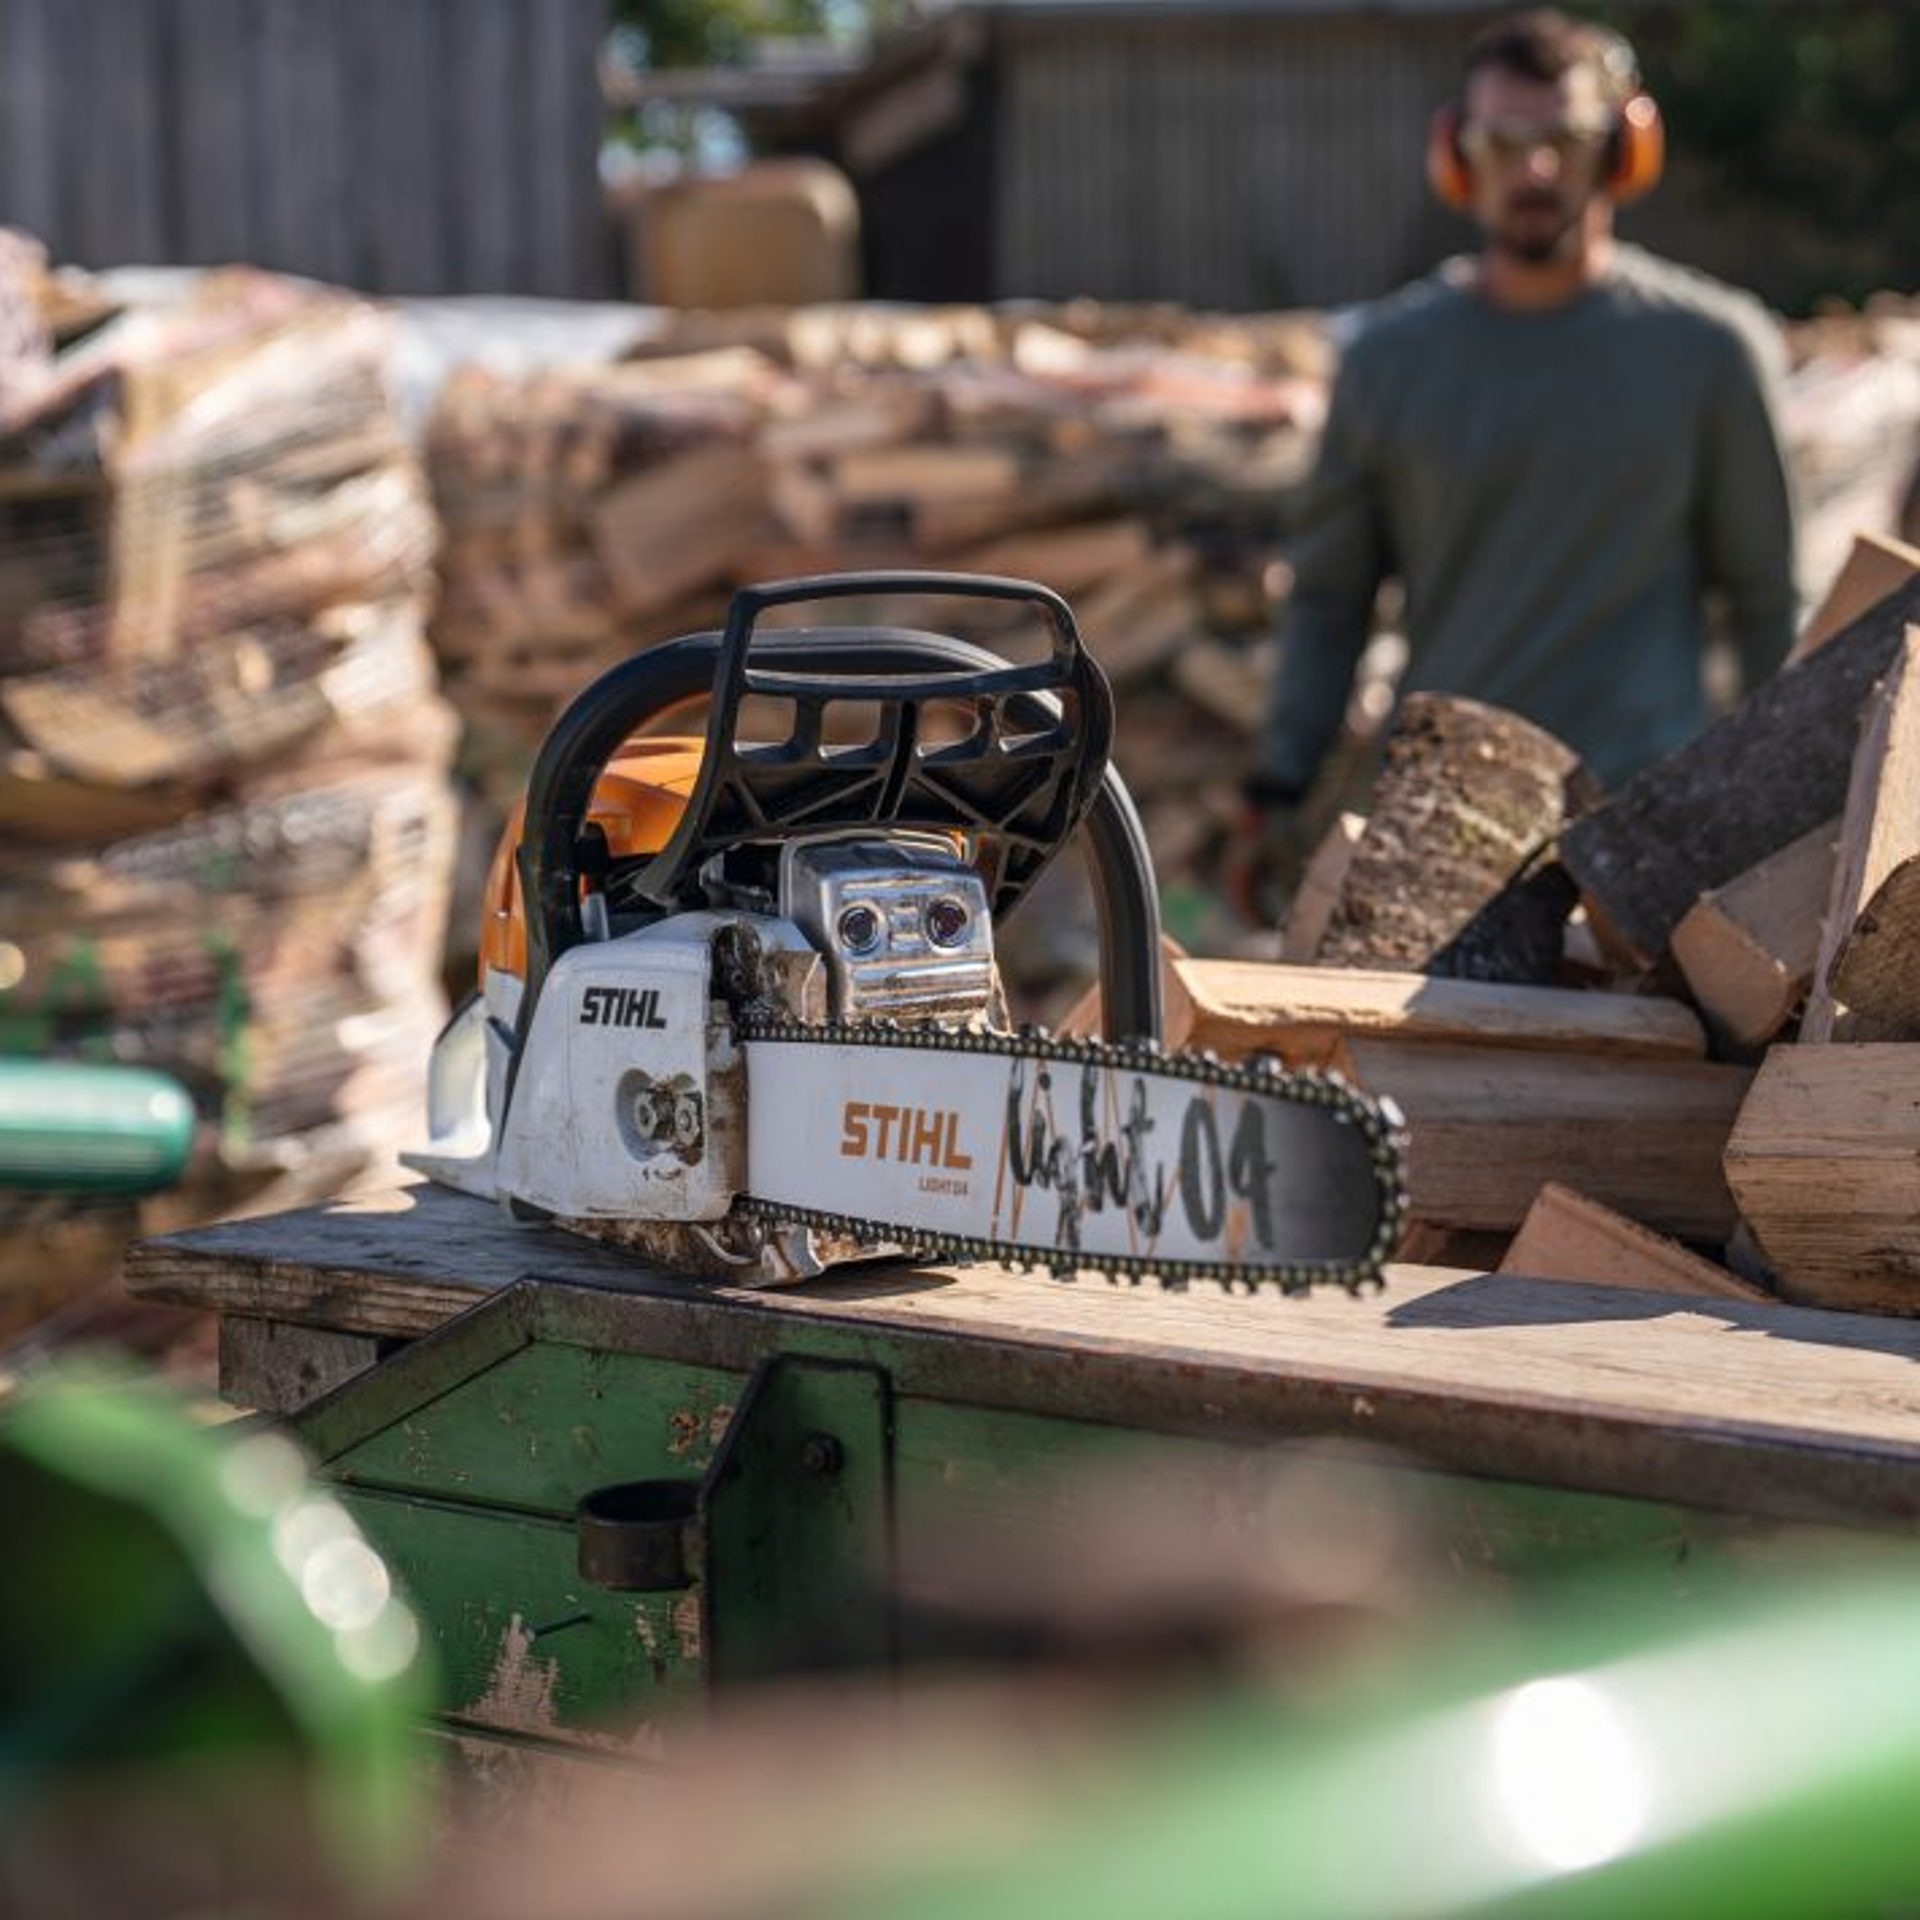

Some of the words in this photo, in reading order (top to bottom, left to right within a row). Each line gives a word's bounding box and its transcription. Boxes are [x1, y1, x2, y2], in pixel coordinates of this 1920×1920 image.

[580, 986, 667, 1029] STIHL
[841, 1102, 973, 1170] STIHL
[1180, 1096, 1277, 1251] 04
